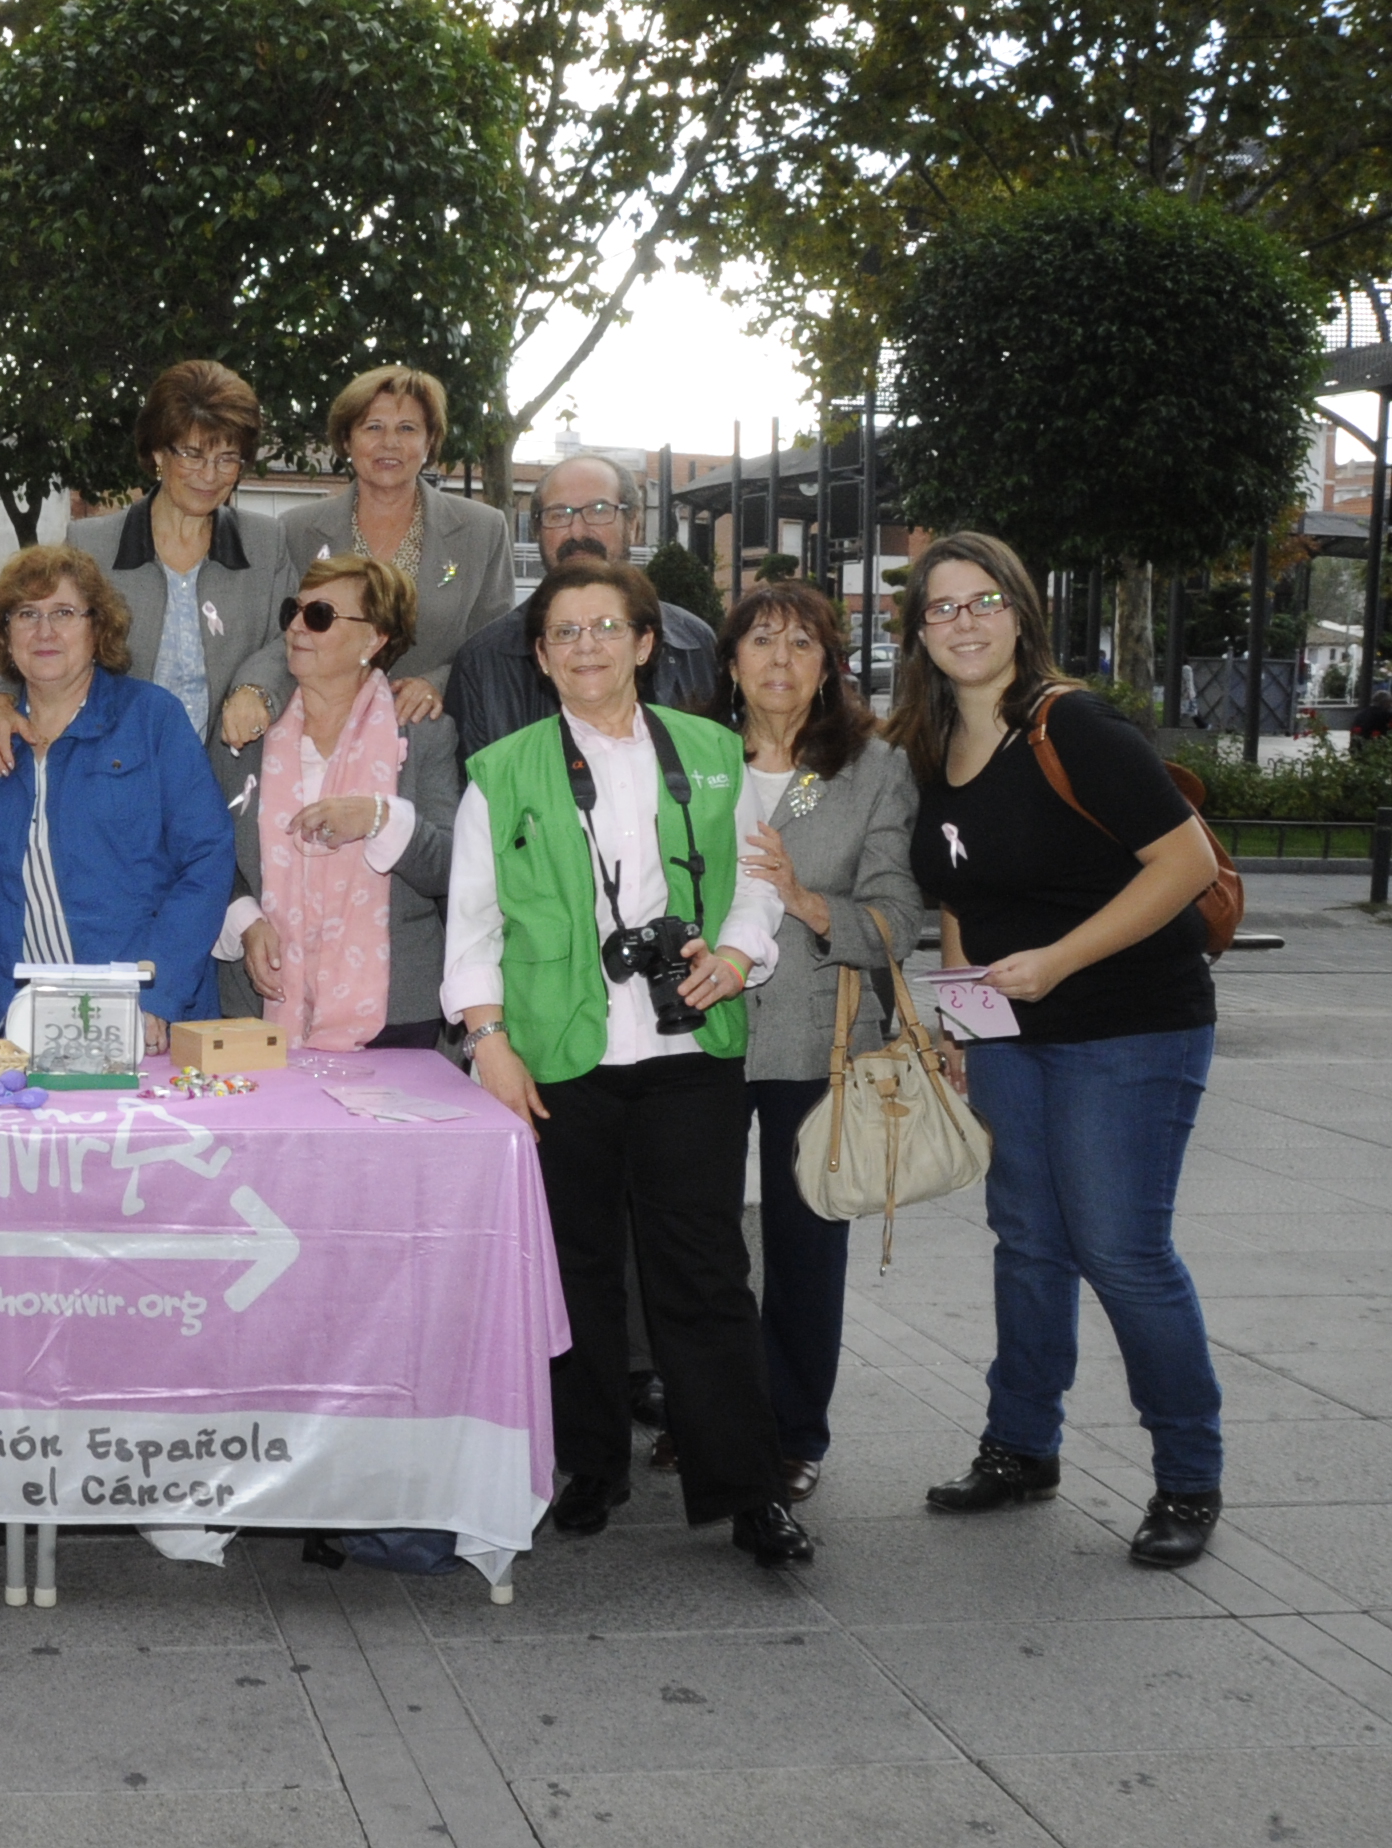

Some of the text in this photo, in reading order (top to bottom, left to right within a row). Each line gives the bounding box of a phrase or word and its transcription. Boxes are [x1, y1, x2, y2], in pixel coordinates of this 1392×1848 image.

[86, 1422, 293, 1478] Española
[22, 1466, 59, 1507] el
[80, 1475, 236, 1507] Cáncer
